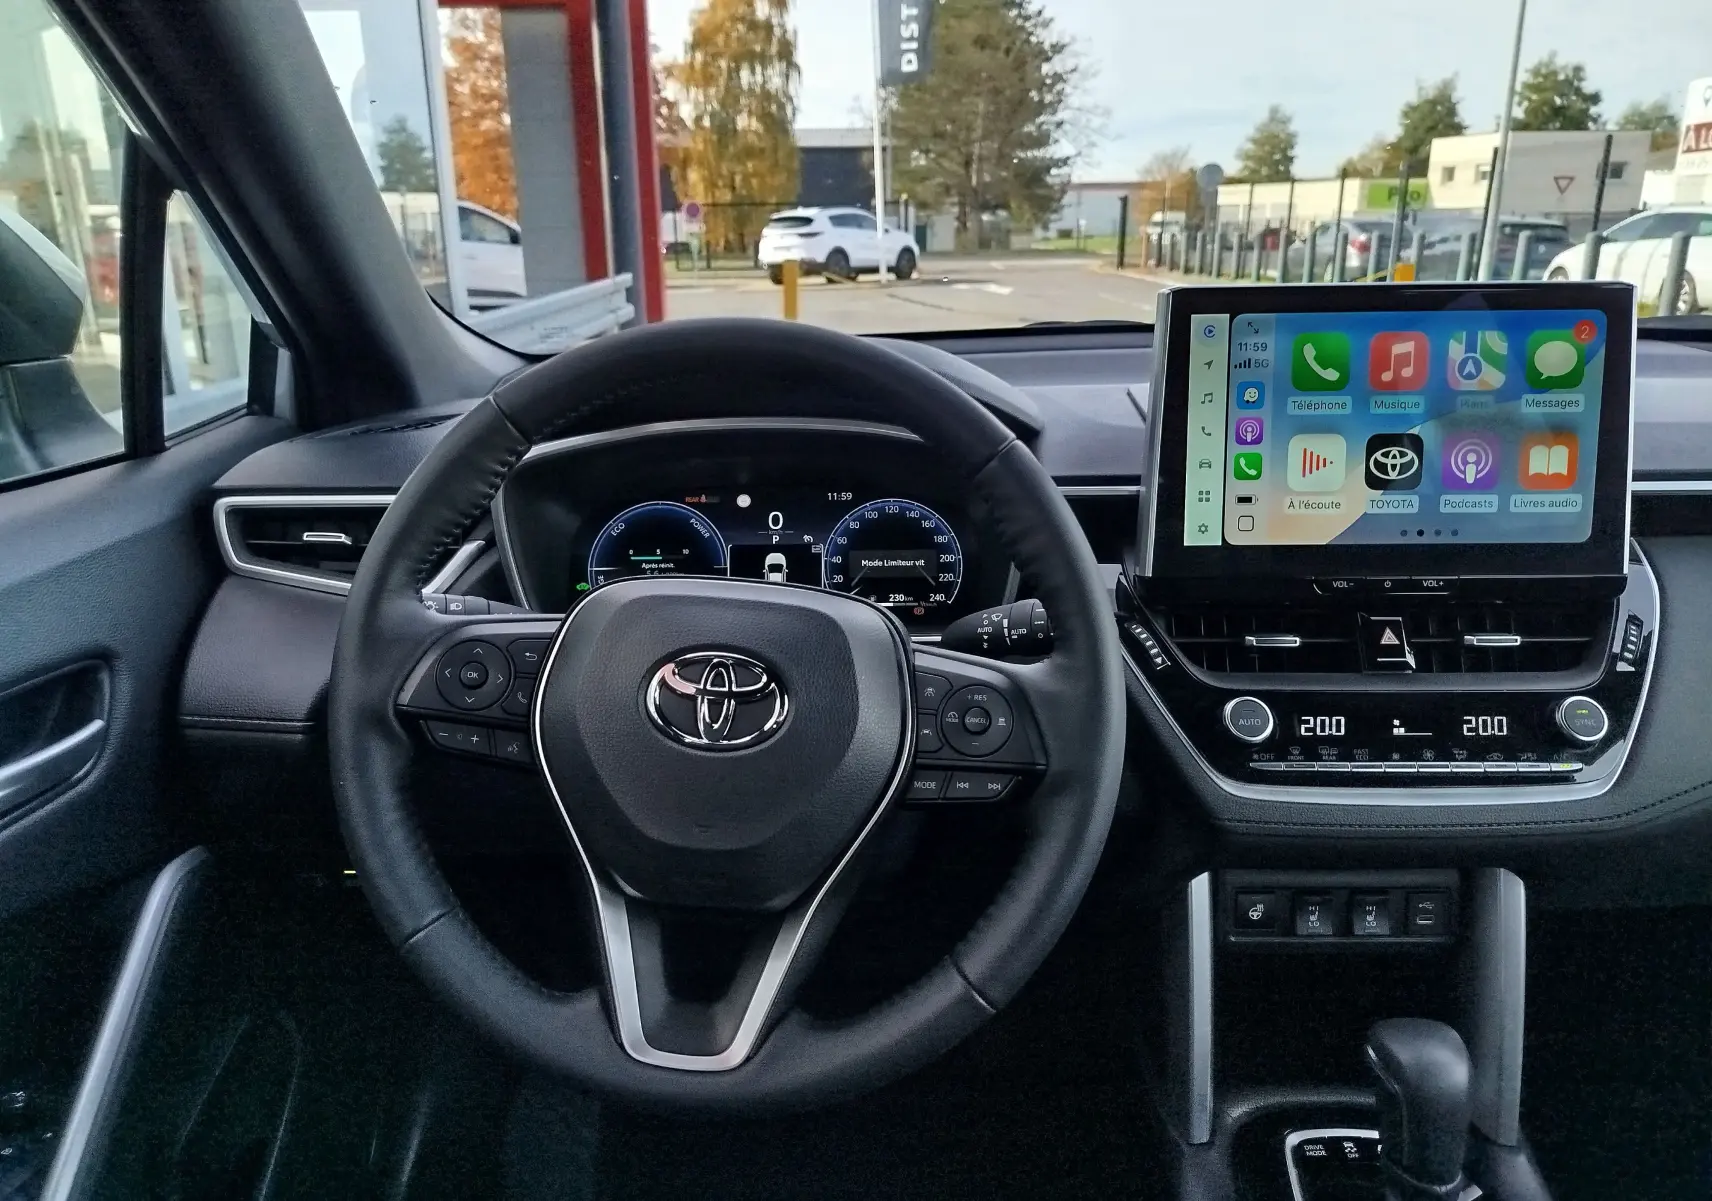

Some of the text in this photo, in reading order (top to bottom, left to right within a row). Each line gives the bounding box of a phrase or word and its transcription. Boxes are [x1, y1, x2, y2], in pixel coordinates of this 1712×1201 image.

[900, 3, 919, 73] DIST
[1581, 326, 1589, 339] 2
[1237, 342, 1268, 351] 11:59
[1254, 359, 1269, 368] 5G
[1291, 400, 1347, 411] Téléphone
[1374, 400, 1420, 411] Musique
[1525, 398, 1580, 410] Messages
[827, 492, 853, 500] 11:59
[1288, 498, 1341, 509] À l'écoute
[1370, 500, 1414, 509] TOYOTA
[1444, 499, 1493, 508] Podcasts
[1514, 498, 1578, 508] Livres audio
[885, 505, 899, 513] 120
[864, 511, 878, 519] 100
[905, 510, 920, 518] 140
[768, 511, 784, 530] 0
[921, 520, 936, 528] 160
[690, 518, 710, 539] POWER
[849, 521, 860, 529] 80
[610, 522, 626, 537] ECO
[772, 535, 780, 544] P
[837, 536, 847, 544] 60
[933, 535, 948, 543] 180
[831, 555, 842, 563] 40
[861, 559, 883, 567] Mode
[833, 575, 843, 583] 20
[889, 594, 905, 602] 230
[929, 594, 945, 602] 240
[467, 671, 479, 679] OK
[1238, 718, 1261, 726] AUTO
[1300, 716, 1345, 736] 20.0
[1463, 716, 1507, 736] 20.0
[1575, 718, 1596, 726] SYNC
[1260, 753, 1275, 761] OFF
[914, 781, 936, 789] MODE
